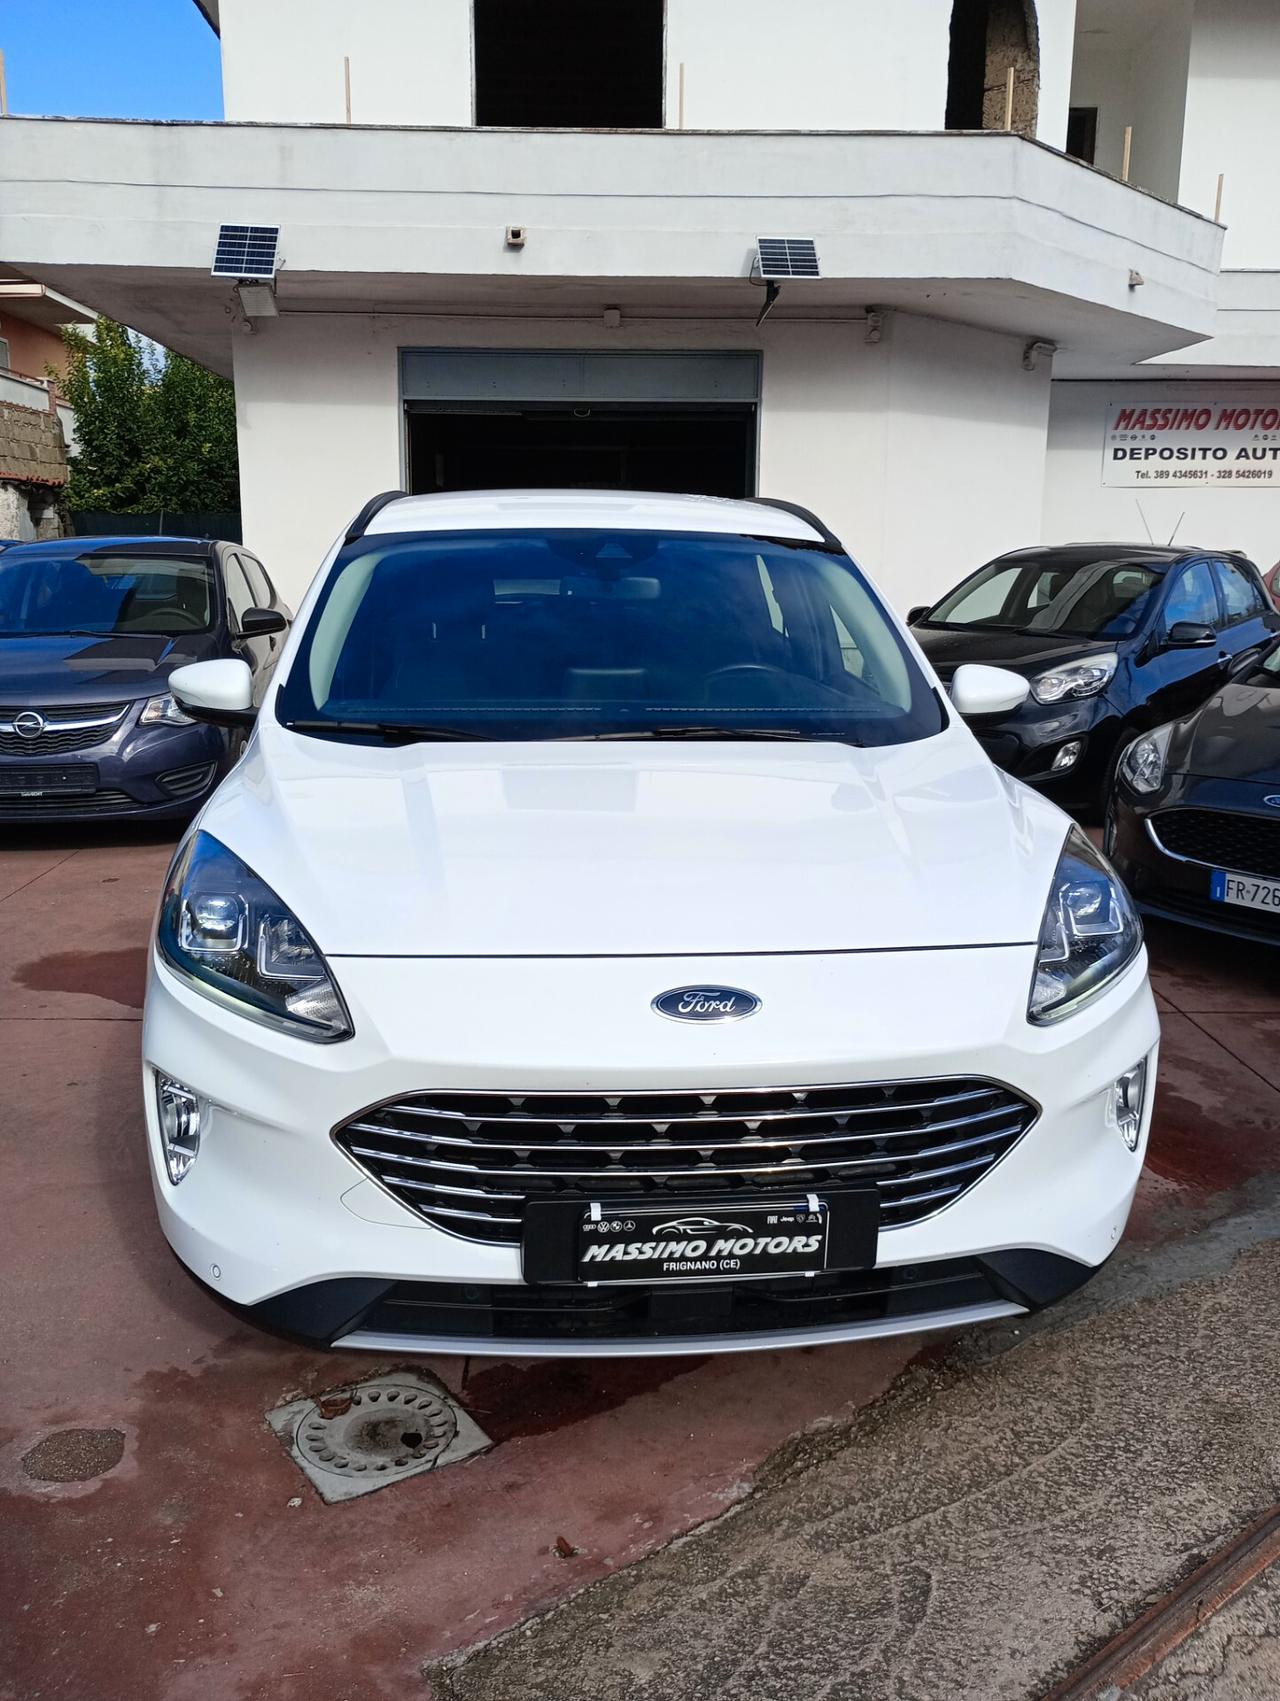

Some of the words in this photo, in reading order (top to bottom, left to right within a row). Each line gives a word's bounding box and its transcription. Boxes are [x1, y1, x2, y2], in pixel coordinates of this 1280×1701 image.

[1113, 408, 1212, 431] MASSIMO
[1215, 408, 1280, 431] MOTO
[1113, 447, 1227, 461] DEPOSITO
[1135, 470, 1151, 479] Tel.
[1153, 470, 1169, 479] 389
[1172, 470, 1208, 479] 4345631
[1216, 470, 1233, 479] 328
[1235, 469, 1273, 479] 5426019
[678, 991, 736, 1013] Ford
[581, 1239, 707, 1263] MASSIMO
[709, 1234, 823, 1257] MOTORS
[663, 1259, 717, 1271] FRIGNANO
[719, 1258, 741, 1271] (CE)
